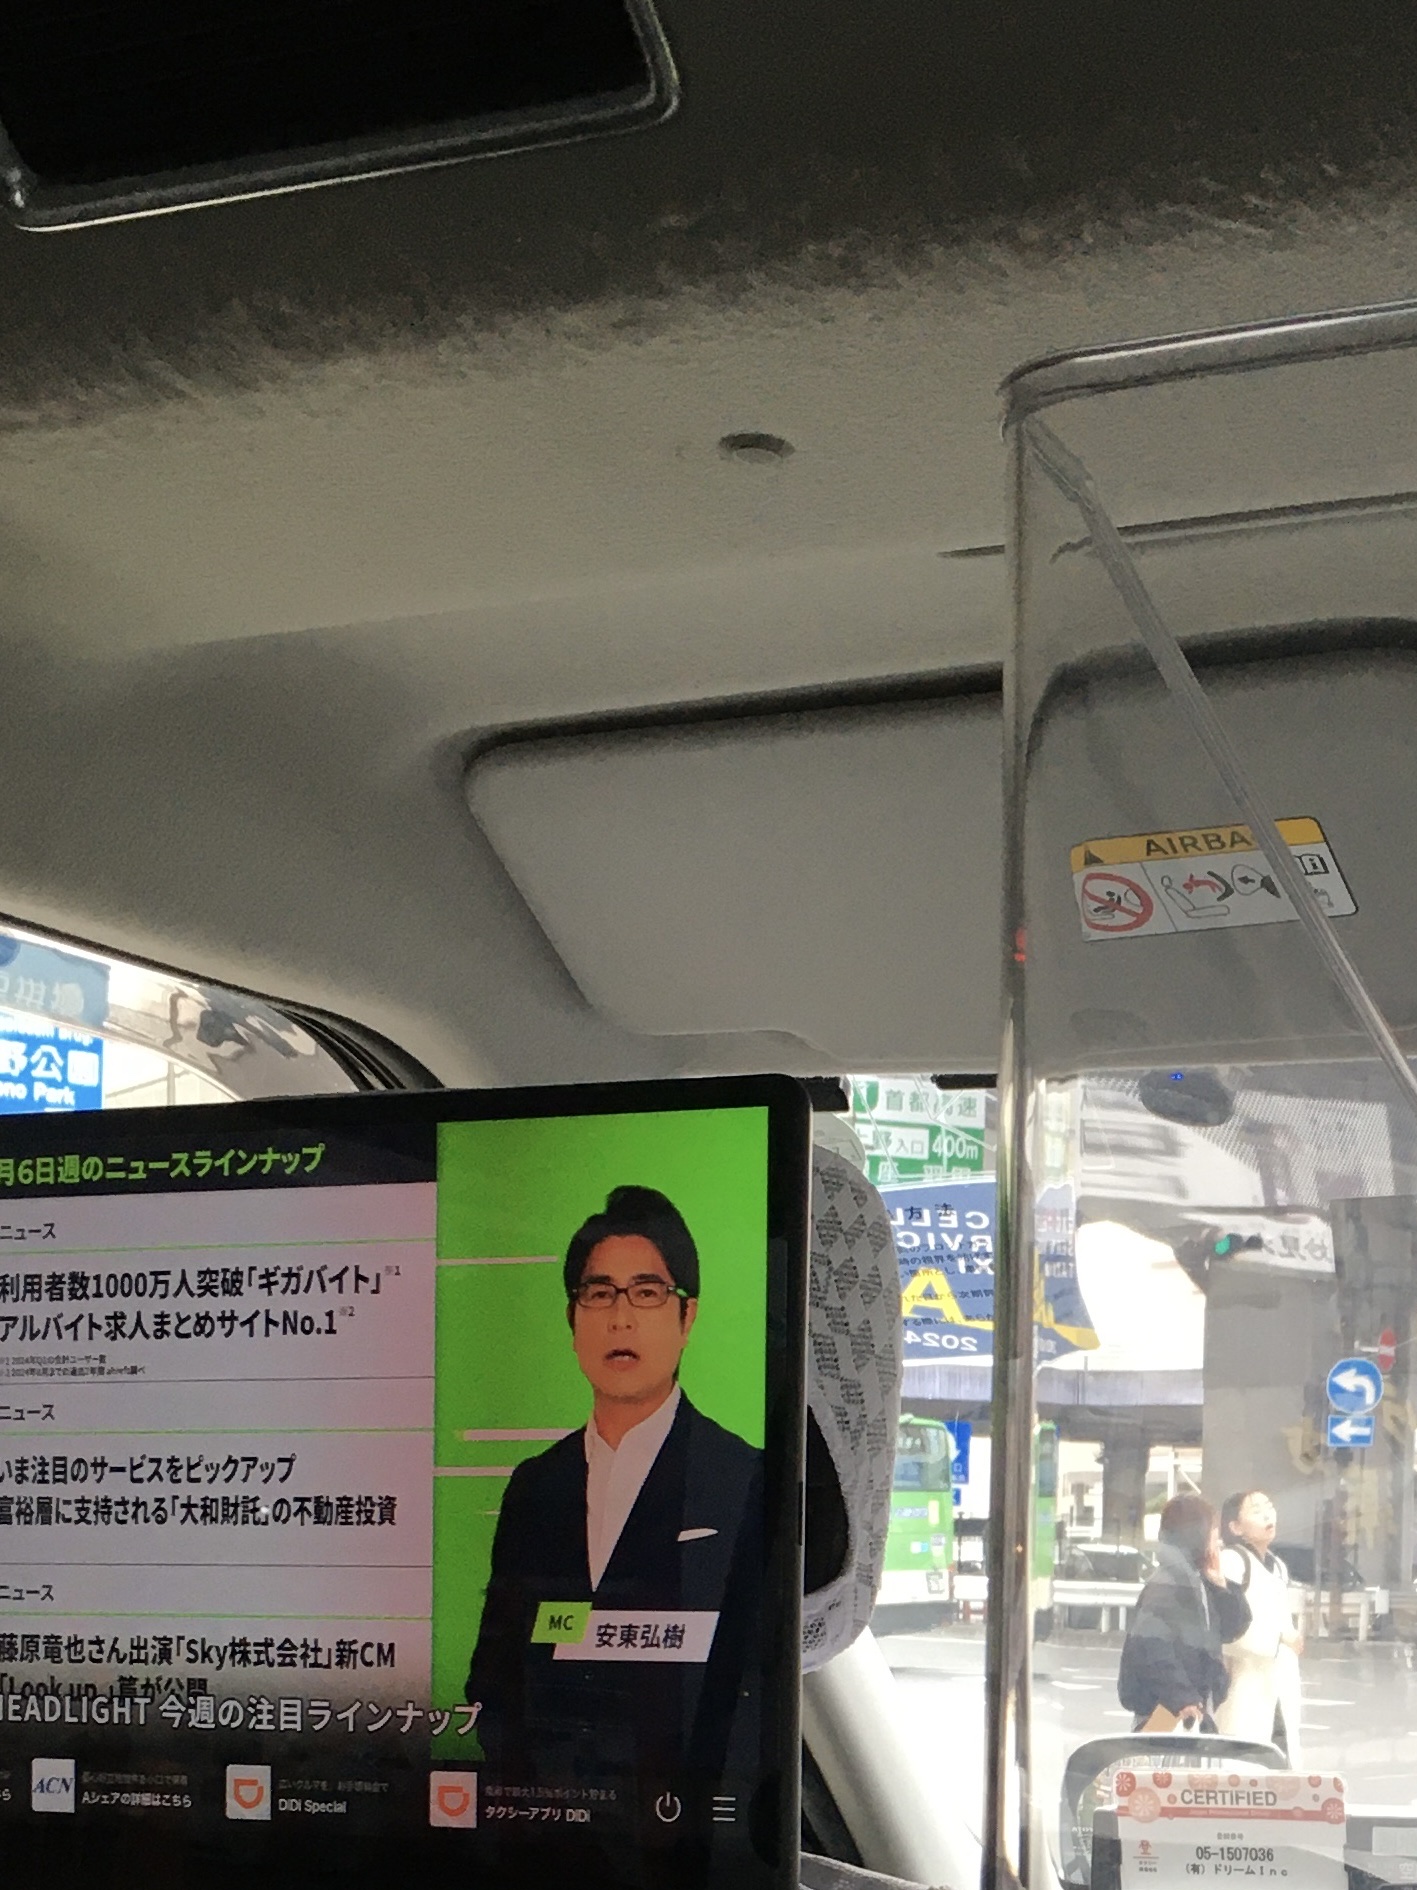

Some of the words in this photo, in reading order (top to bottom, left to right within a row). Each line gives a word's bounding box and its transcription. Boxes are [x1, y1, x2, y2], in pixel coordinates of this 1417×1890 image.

[1145, 830, 1254, 857] AIRBA
[1, 1453, 297, 1486] いま注目のサービスをピックアップ
[548, 1614, 575, 1631] MC
[0, 1694, 151, 1726] EADLIGHT
[159, 1694, 483, 1737] 今週の注目ラインナップ
[32, 1777, 75, 1795] ACN
[304, 1799, 347, 1815] Special
[1180, 1789, 1278, 1807] CERTIFIED
[485, 1805, 562, 1821] タクシーアプリ
[1195, 1845, 1275, 1863] 05-1507036
